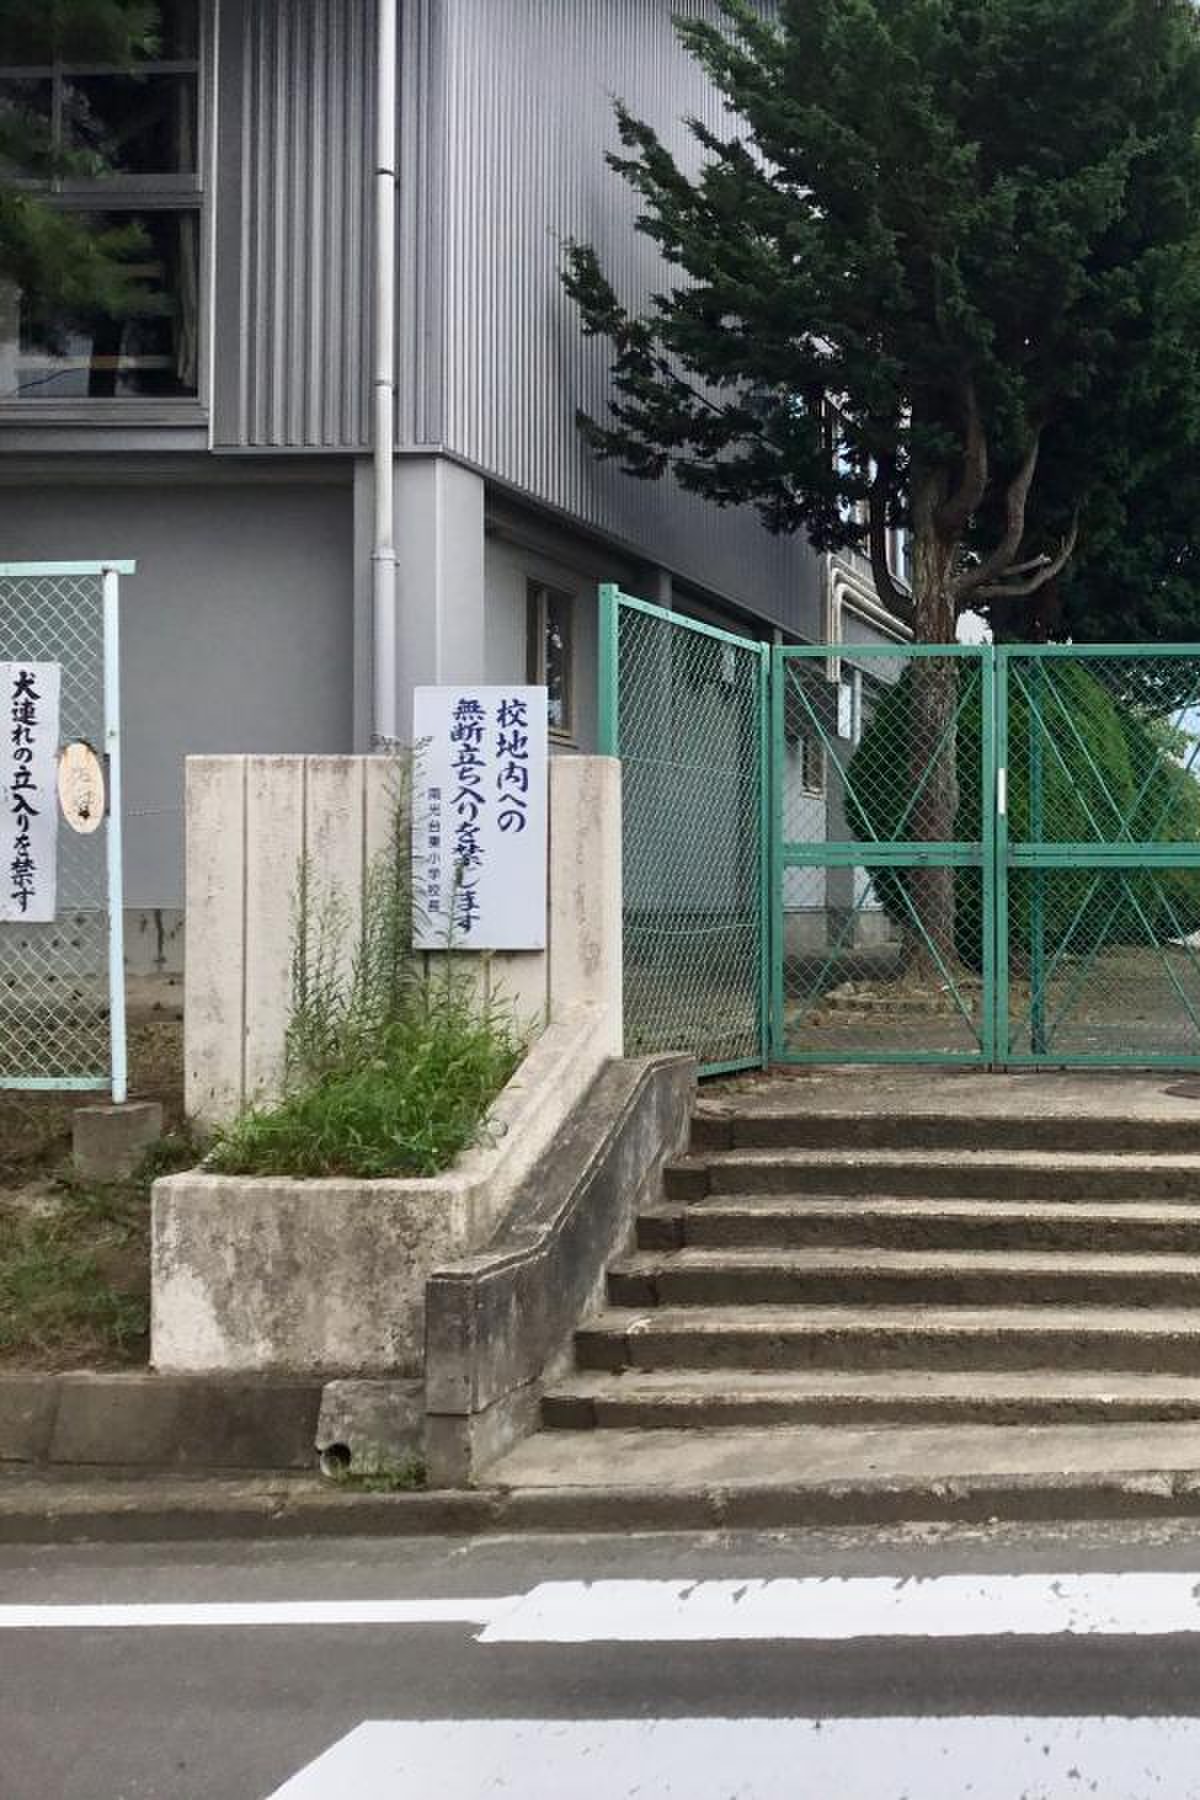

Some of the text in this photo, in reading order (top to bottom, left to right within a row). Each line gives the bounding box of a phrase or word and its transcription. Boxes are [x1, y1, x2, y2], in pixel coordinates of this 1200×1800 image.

[495, 698, 529, 833] 校地内への
